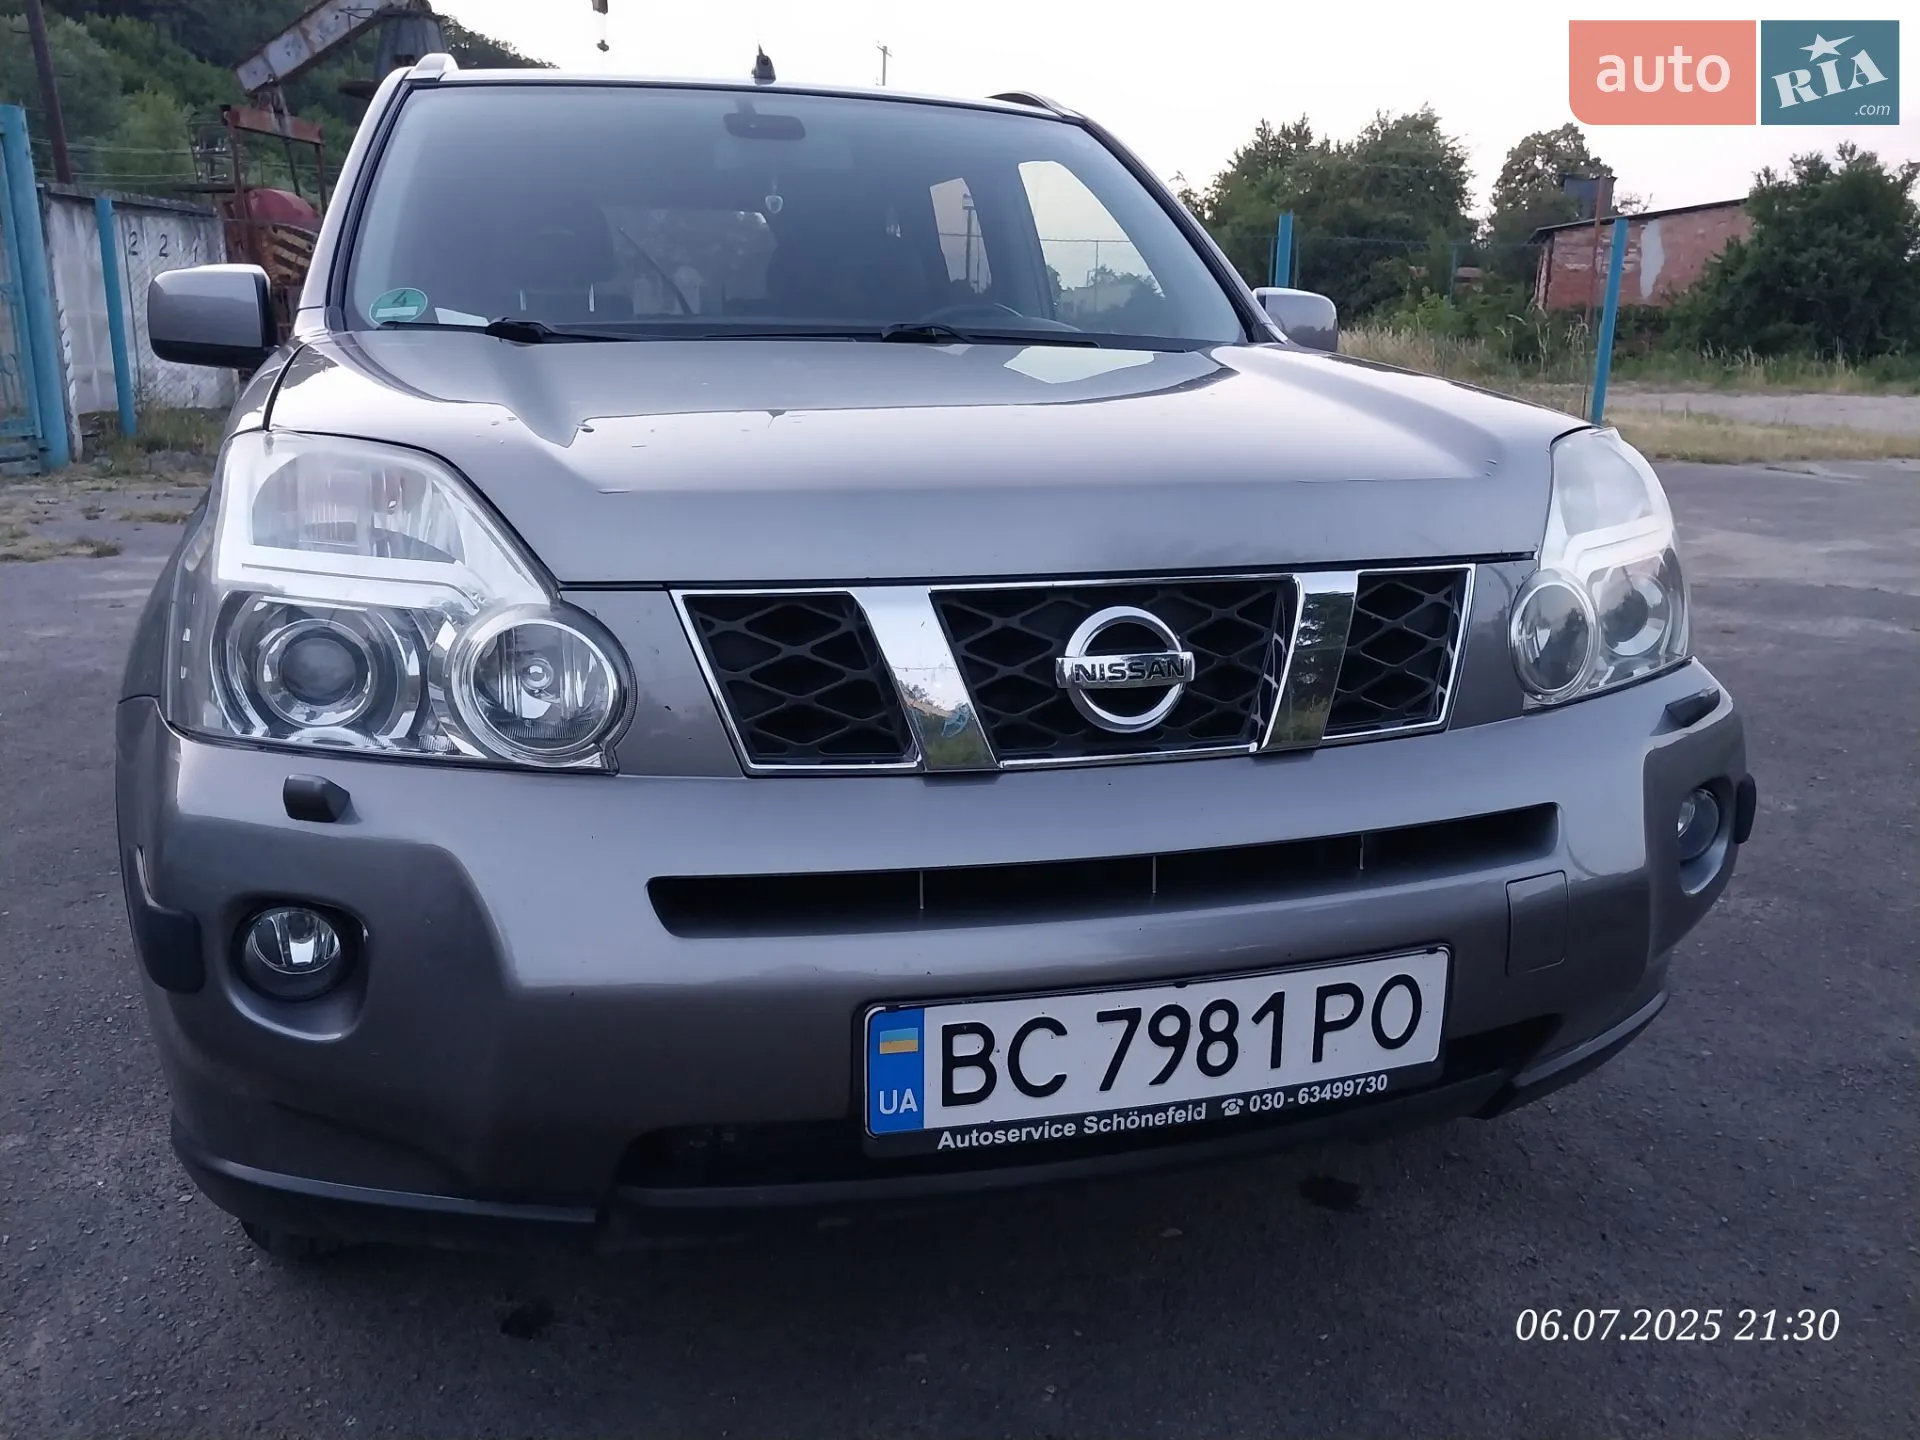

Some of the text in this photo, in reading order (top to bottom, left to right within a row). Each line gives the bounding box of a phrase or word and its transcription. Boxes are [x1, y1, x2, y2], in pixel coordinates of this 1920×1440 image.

[1075, 658, 1185, 683] NISSAN
[941, 974, 1422, 1108] BC 7981 PO
[878, 1088, 919, 1115] UA
[937, 1120, 1077, 1150] Autoservice
[1083, 1102, 1207, 1135] Schönefeld
